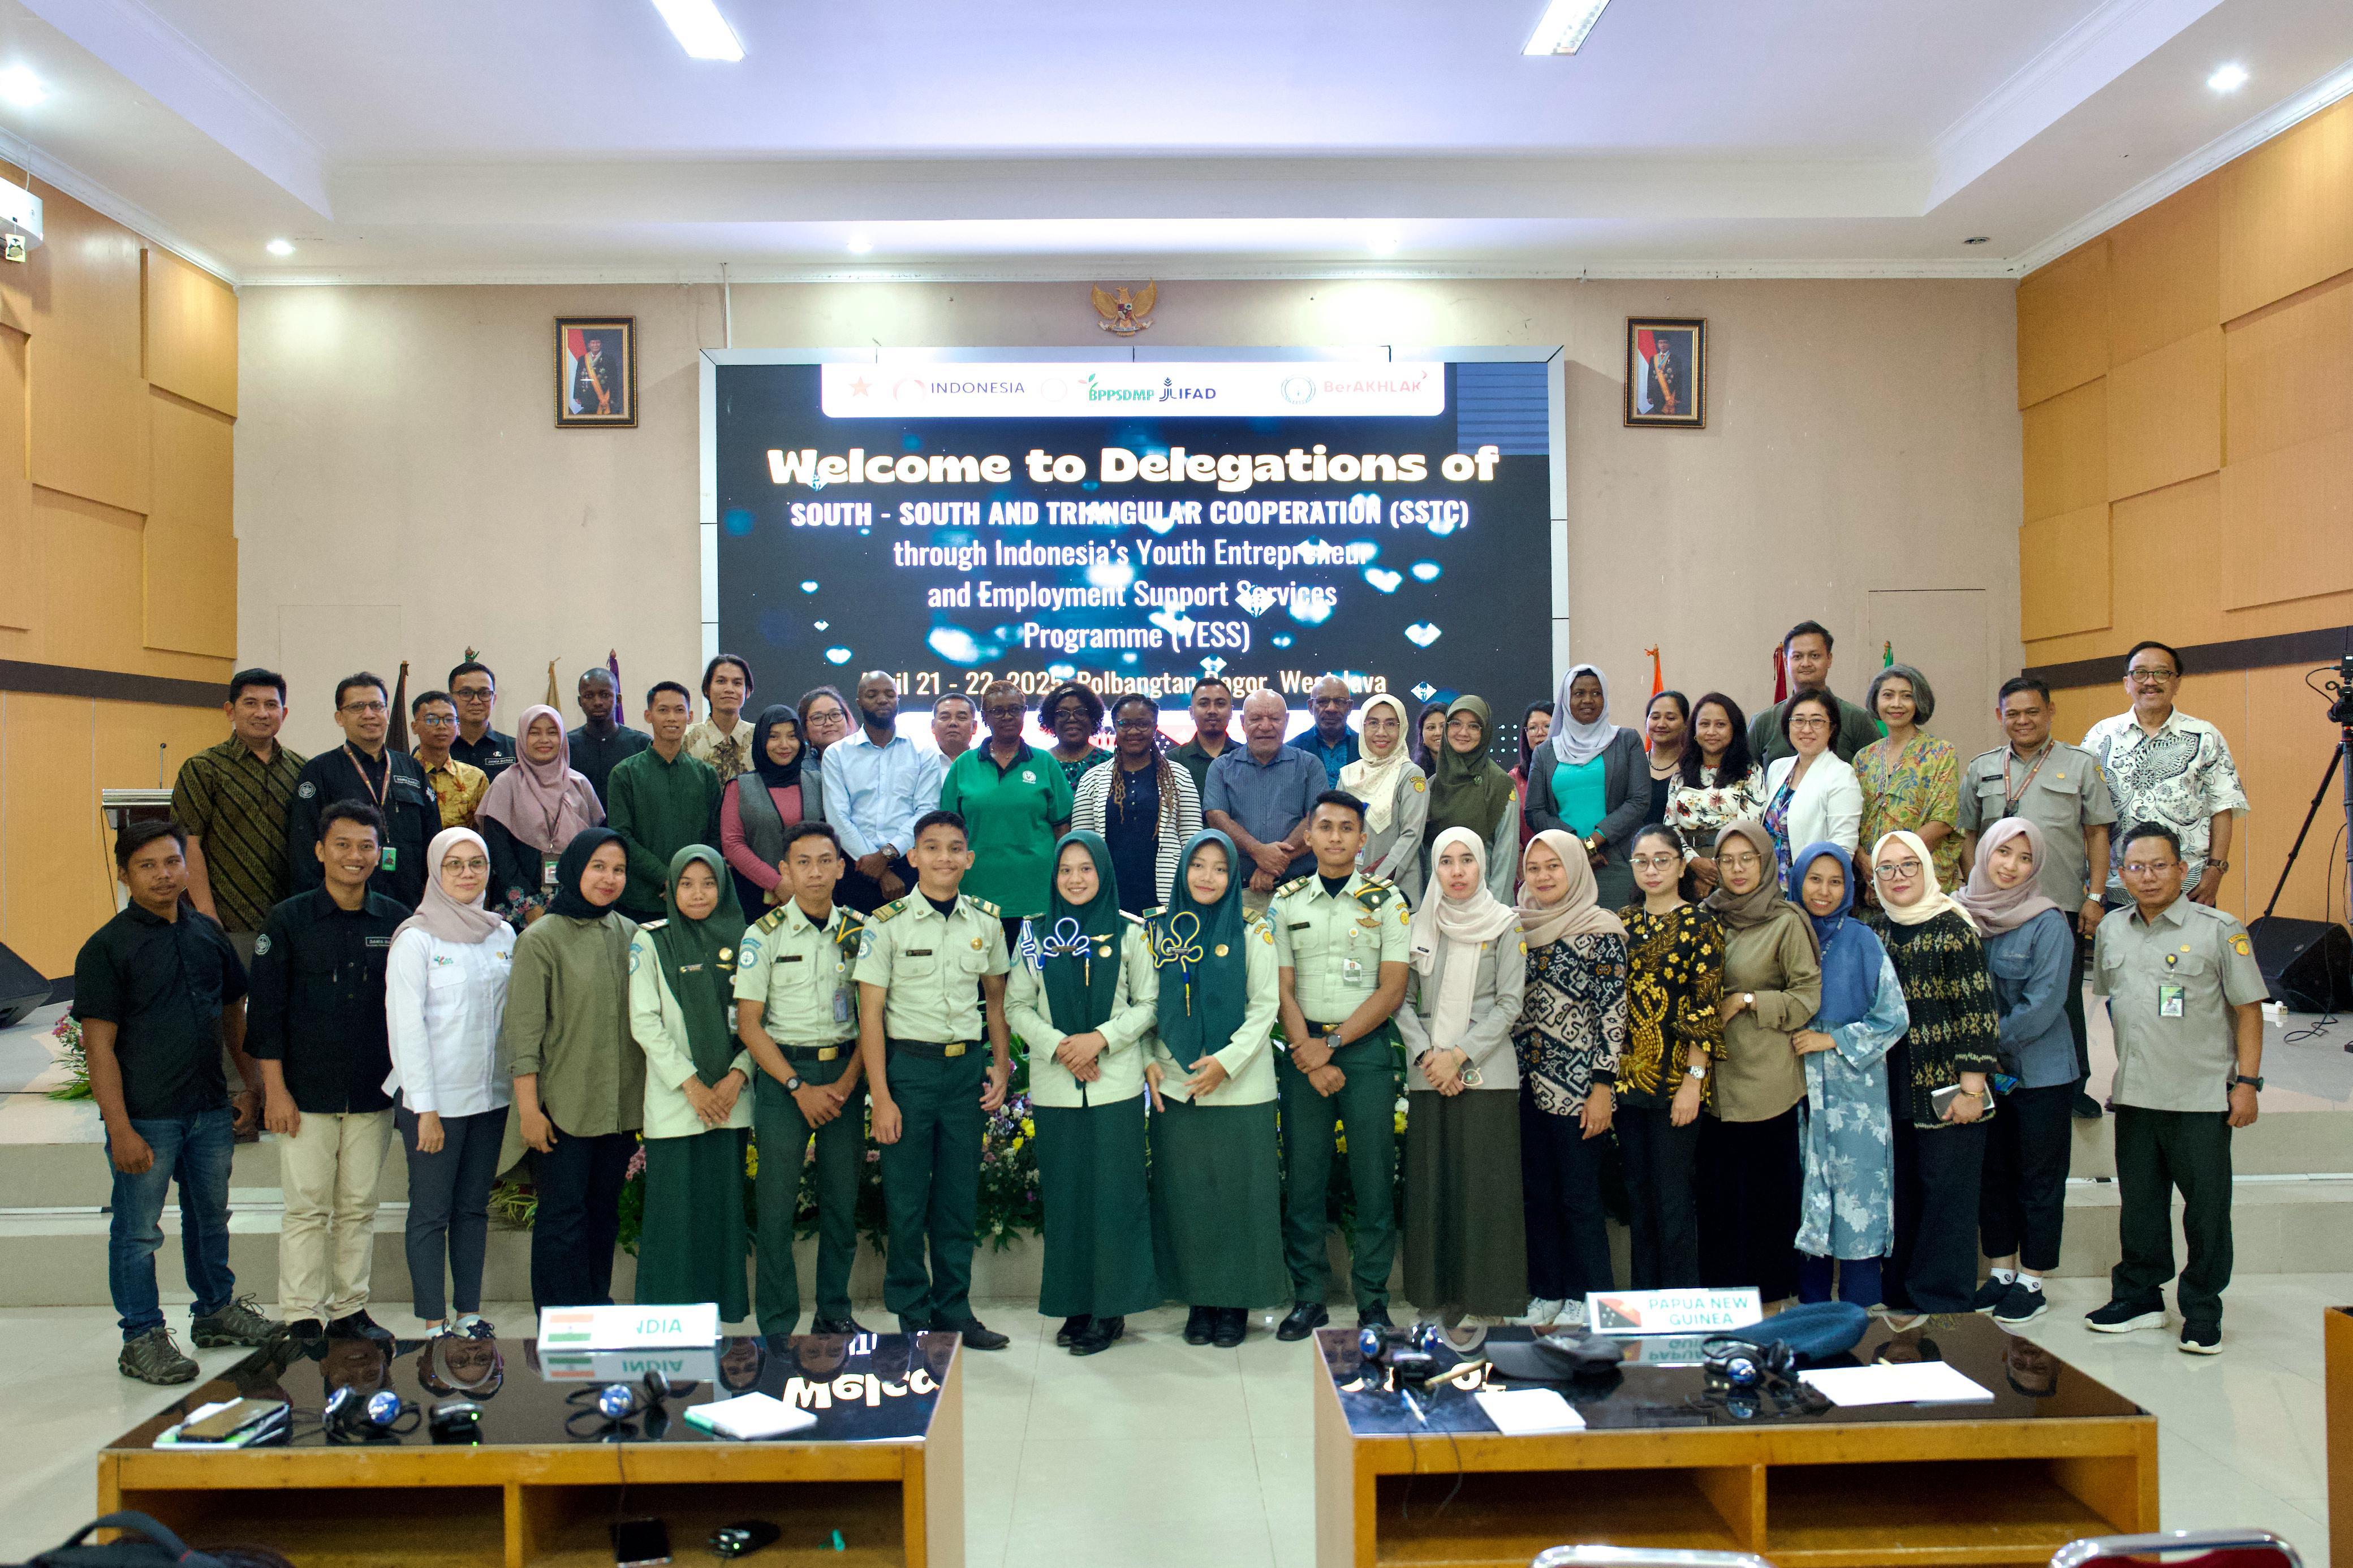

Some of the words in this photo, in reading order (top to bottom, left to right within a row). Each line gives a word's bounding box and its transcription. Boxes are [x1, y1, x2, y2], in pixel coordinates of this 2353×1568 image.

[932, 382, 1025, 394] INDONESIA
[1089, 388, 1154, 401] BPPSDMP
[1179, 388, 1217, 399] IFAD
[1324, 381, 1421, 392] BerAKHLAK
[768, 448, 1011, 484] Welcome
[1025, 449, 1086, 482] to
[1101, 444, 1428, 492] Delegations
[1442, 446, 1499, 481] of
[791, 503, 872, 526] SOUTH
[899, 502, 980, 526] SOUTH
[989, 502, 1039, 525] AND
[1046, 501, 1203, 525] TRIANGULAR
[1210, 501, 1381, 525] COOPERATION
[1390, 500, 1469, 529] (SSTC)
[894, 540, 987, 571] through
[1136, 539, 1205, 565] Youth
[1214, 539, 1368, 571] Entrepreneur
[928, 581, 971, 607] and
[979, 581, 1127, 612] Employment
[1134, 580, 1229, 612] Support
[1236, 580, 1338, 607] Services
[1024, 622, 1163, 653] Programme
[1172, 621, 1250, 654] (YESS)
[916, 671, 940, 695] 21
[1077, 671, 1196, 698] Polbangtan
[1649, 1298, 1705, 1310] PAPUA
[1711, 1297, 1747, 1308] NEW
[1670, 1312, 1733, 1325] GUINEA
